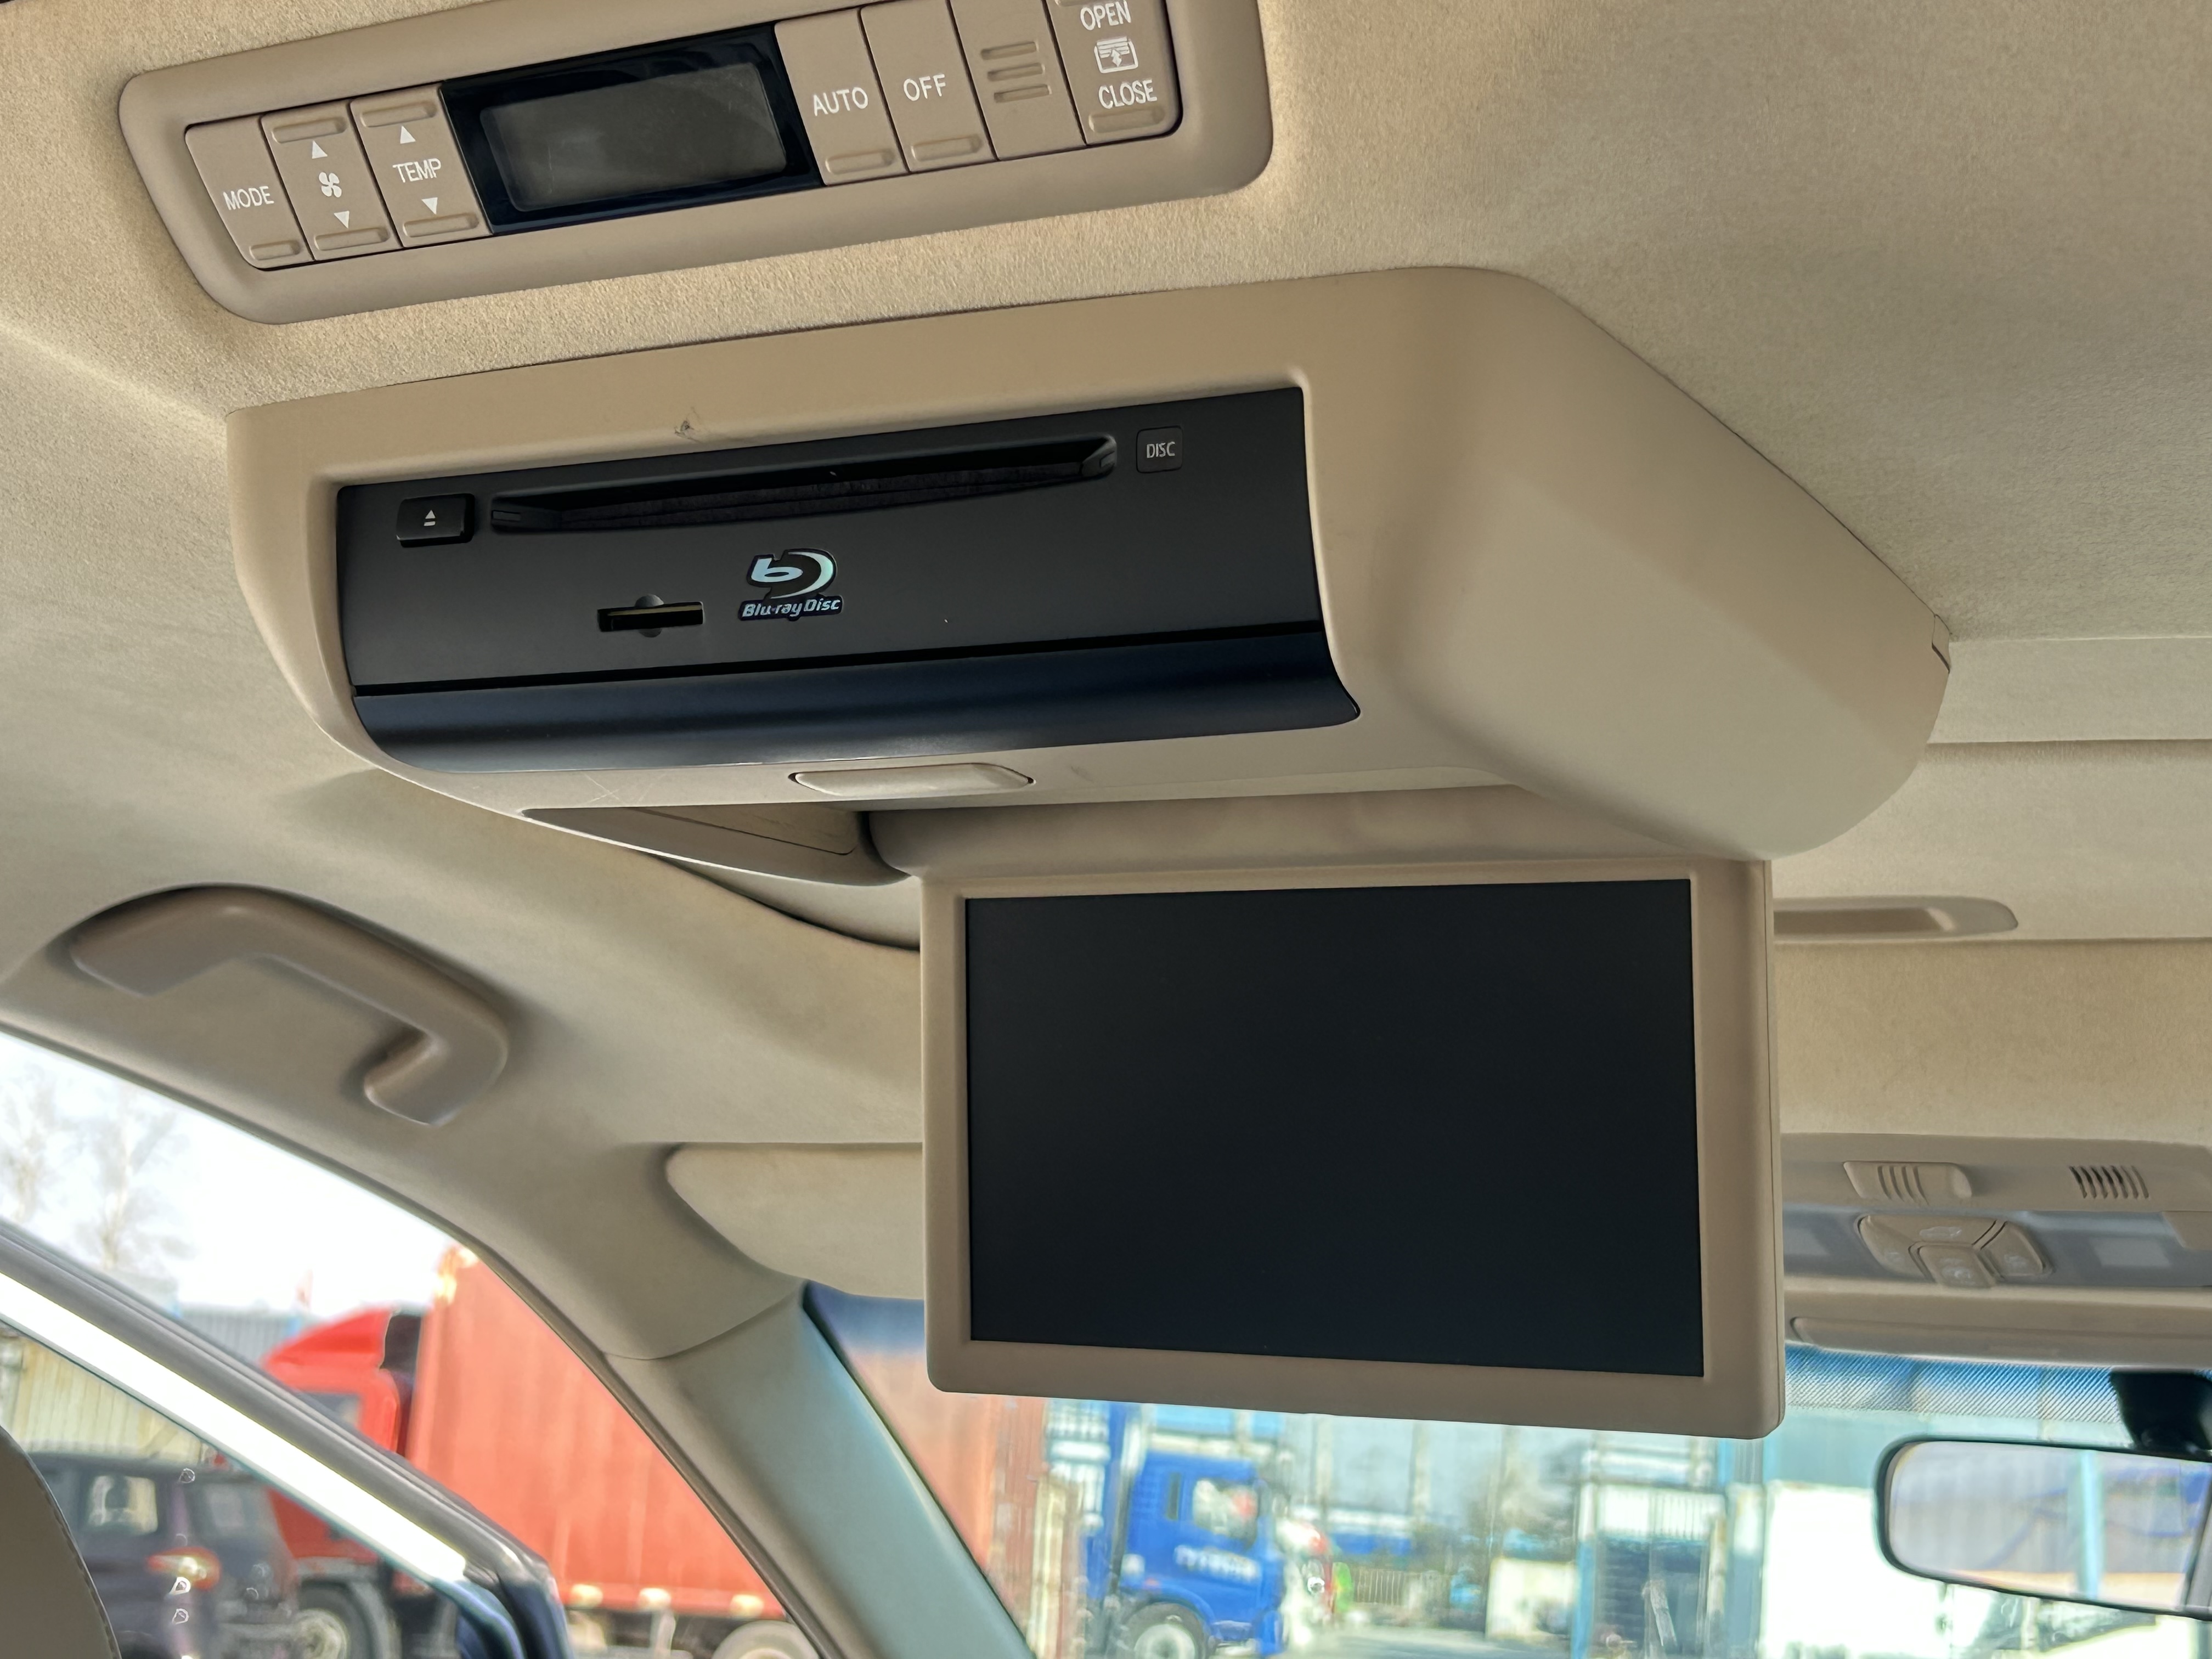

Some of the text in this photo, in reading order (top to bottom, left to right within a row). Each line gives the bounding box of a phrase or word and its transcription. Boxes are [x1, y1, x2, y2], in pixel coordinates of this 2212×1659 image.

[1080, 1, 1131, 30] OPEN
[903, 74, 946, 101] OFF
[1098, 80, 1158, 109] CLOSE
[813, 87, 868, 116] AUTO
[392, 158, 441, 183] TEMP
[223, 186, 274, 210] MODE
[1146, 441, 1176, 459] DISC
[803, 599, 841, 612] Disc
